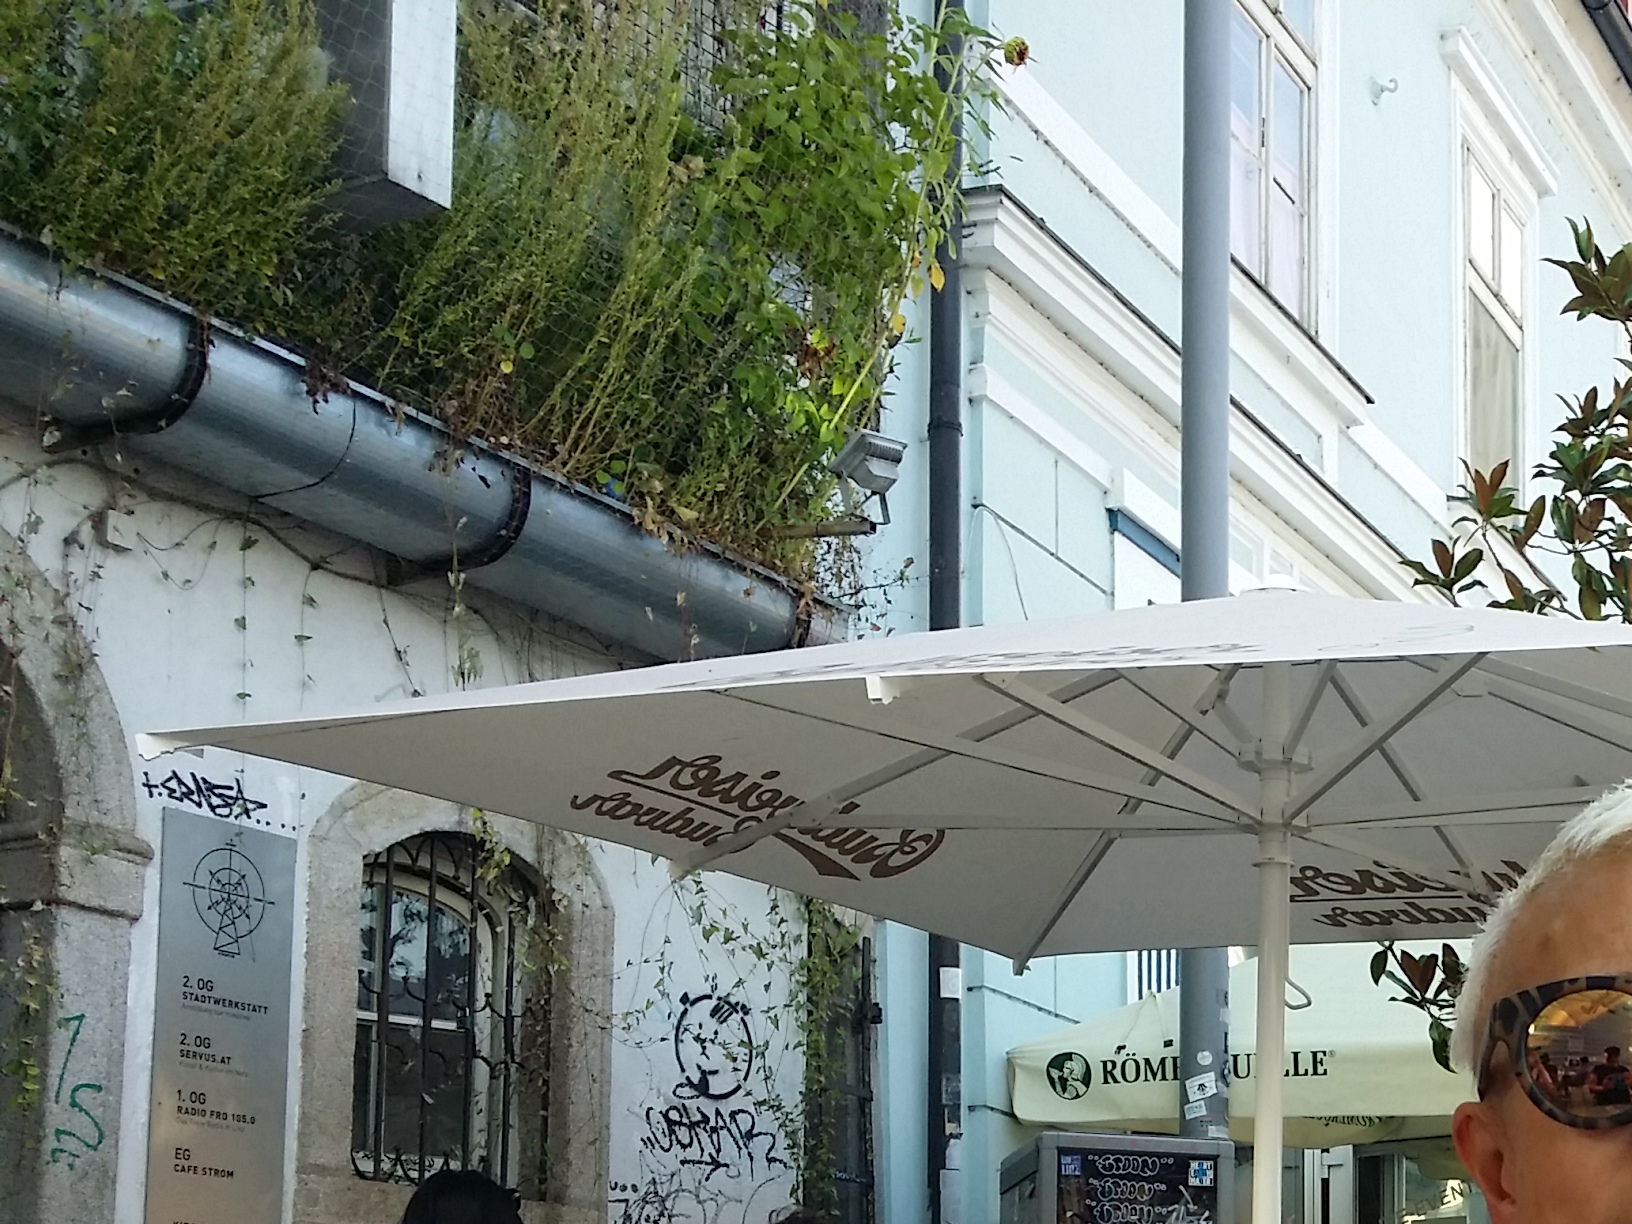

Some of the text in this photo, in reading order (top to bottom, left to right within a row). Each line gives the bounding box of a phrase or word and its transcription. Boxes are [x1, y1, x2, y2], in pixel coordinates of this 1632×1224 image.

[182, 975, 214, 992] 2. OG
[182, 991, 268, 1015] STADTWERKSTATT
[179, 1033, 211, 1049] 2. OG
[179, 1049, 232, 1065] SERVUS.AT
[177, 1089, 207, 1105] 1. OG
[177, 1105, 207, 1117] RADIO
[209, 1110, 228, 1121] FRO
[174, 1147, 191, 1161] EG
[173, 1163, 234, 1179] CAFE STROM
